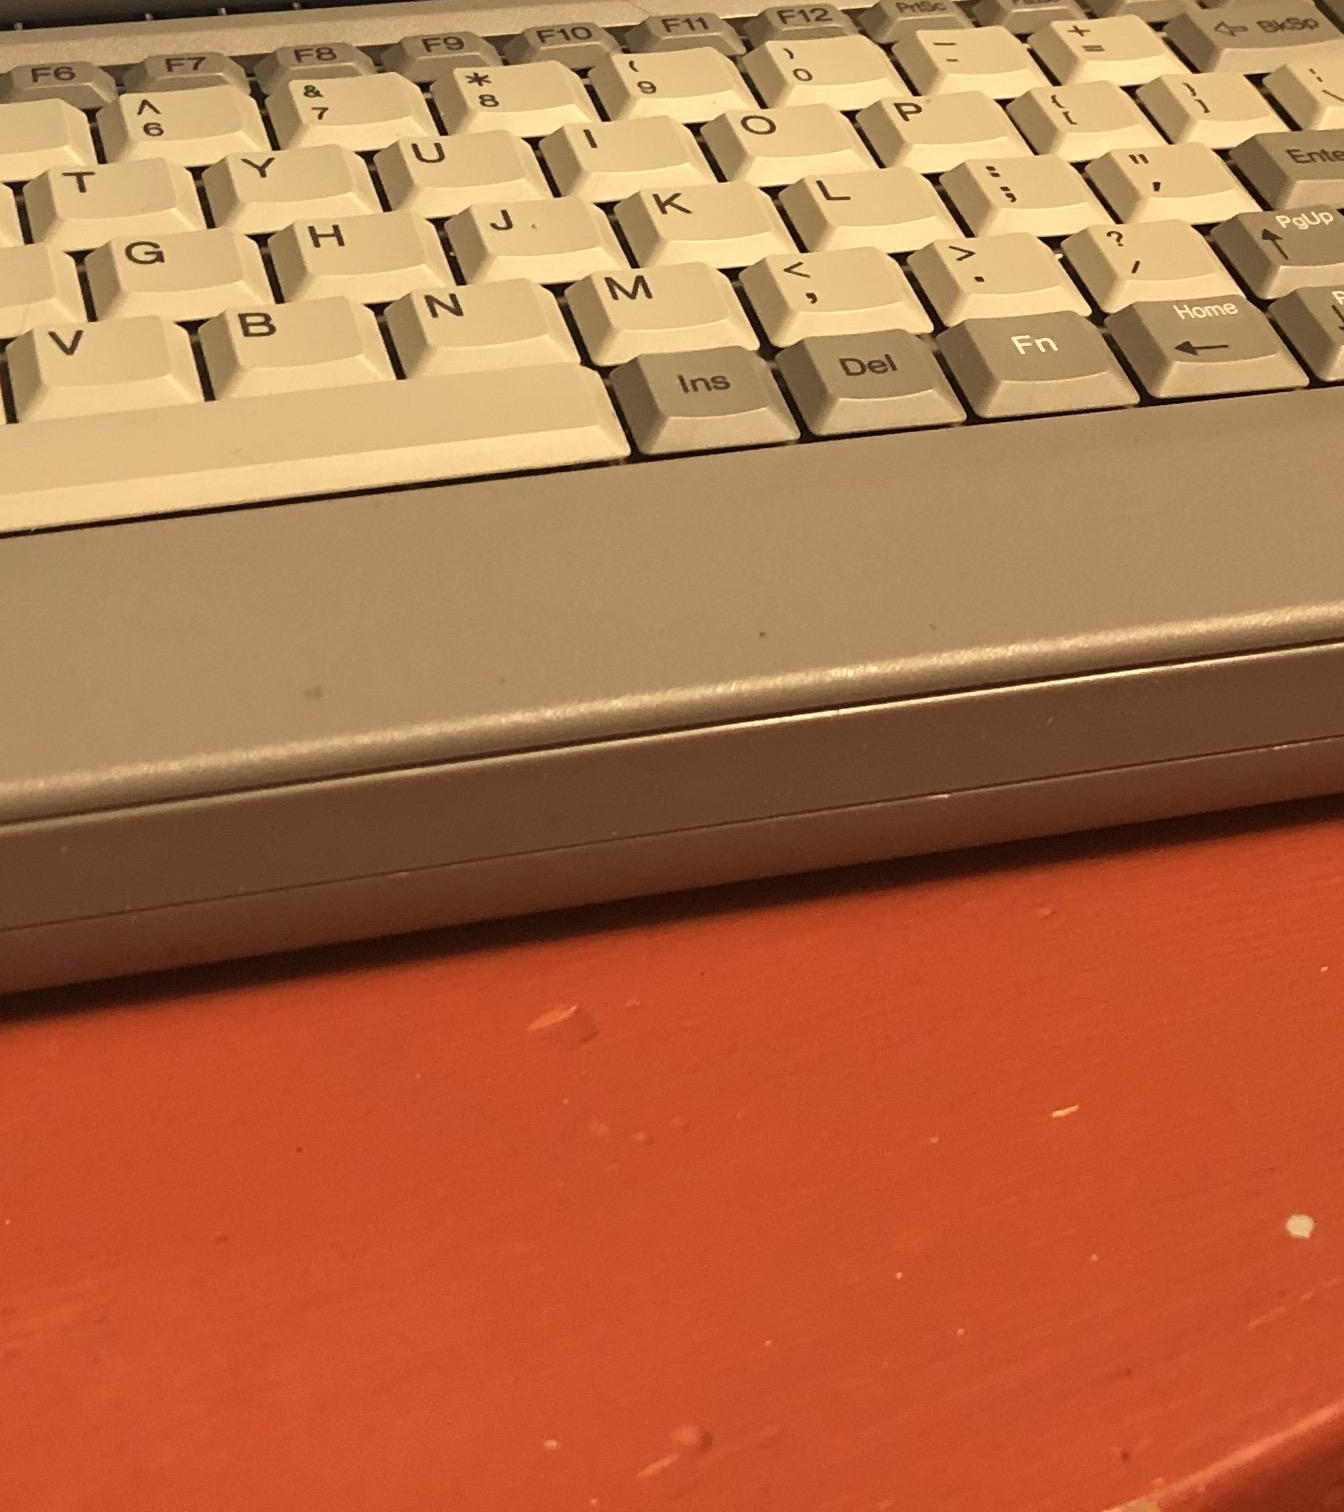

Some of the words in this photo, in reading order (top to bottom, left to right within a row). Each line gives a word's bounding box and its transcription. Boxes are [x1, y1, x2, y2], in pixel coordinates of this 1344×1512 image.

[776, 6, 834, 25] F12
[1256, 16, 1321, 36] BkSp
[1276, 208, 1335, 231] PgUp
[1172, 298, 1240, 321] Home
[1010, 333, 1060, 357] Fn
[837, 353, 899, 378] Del
[677, 371, 732, 395] Ins
